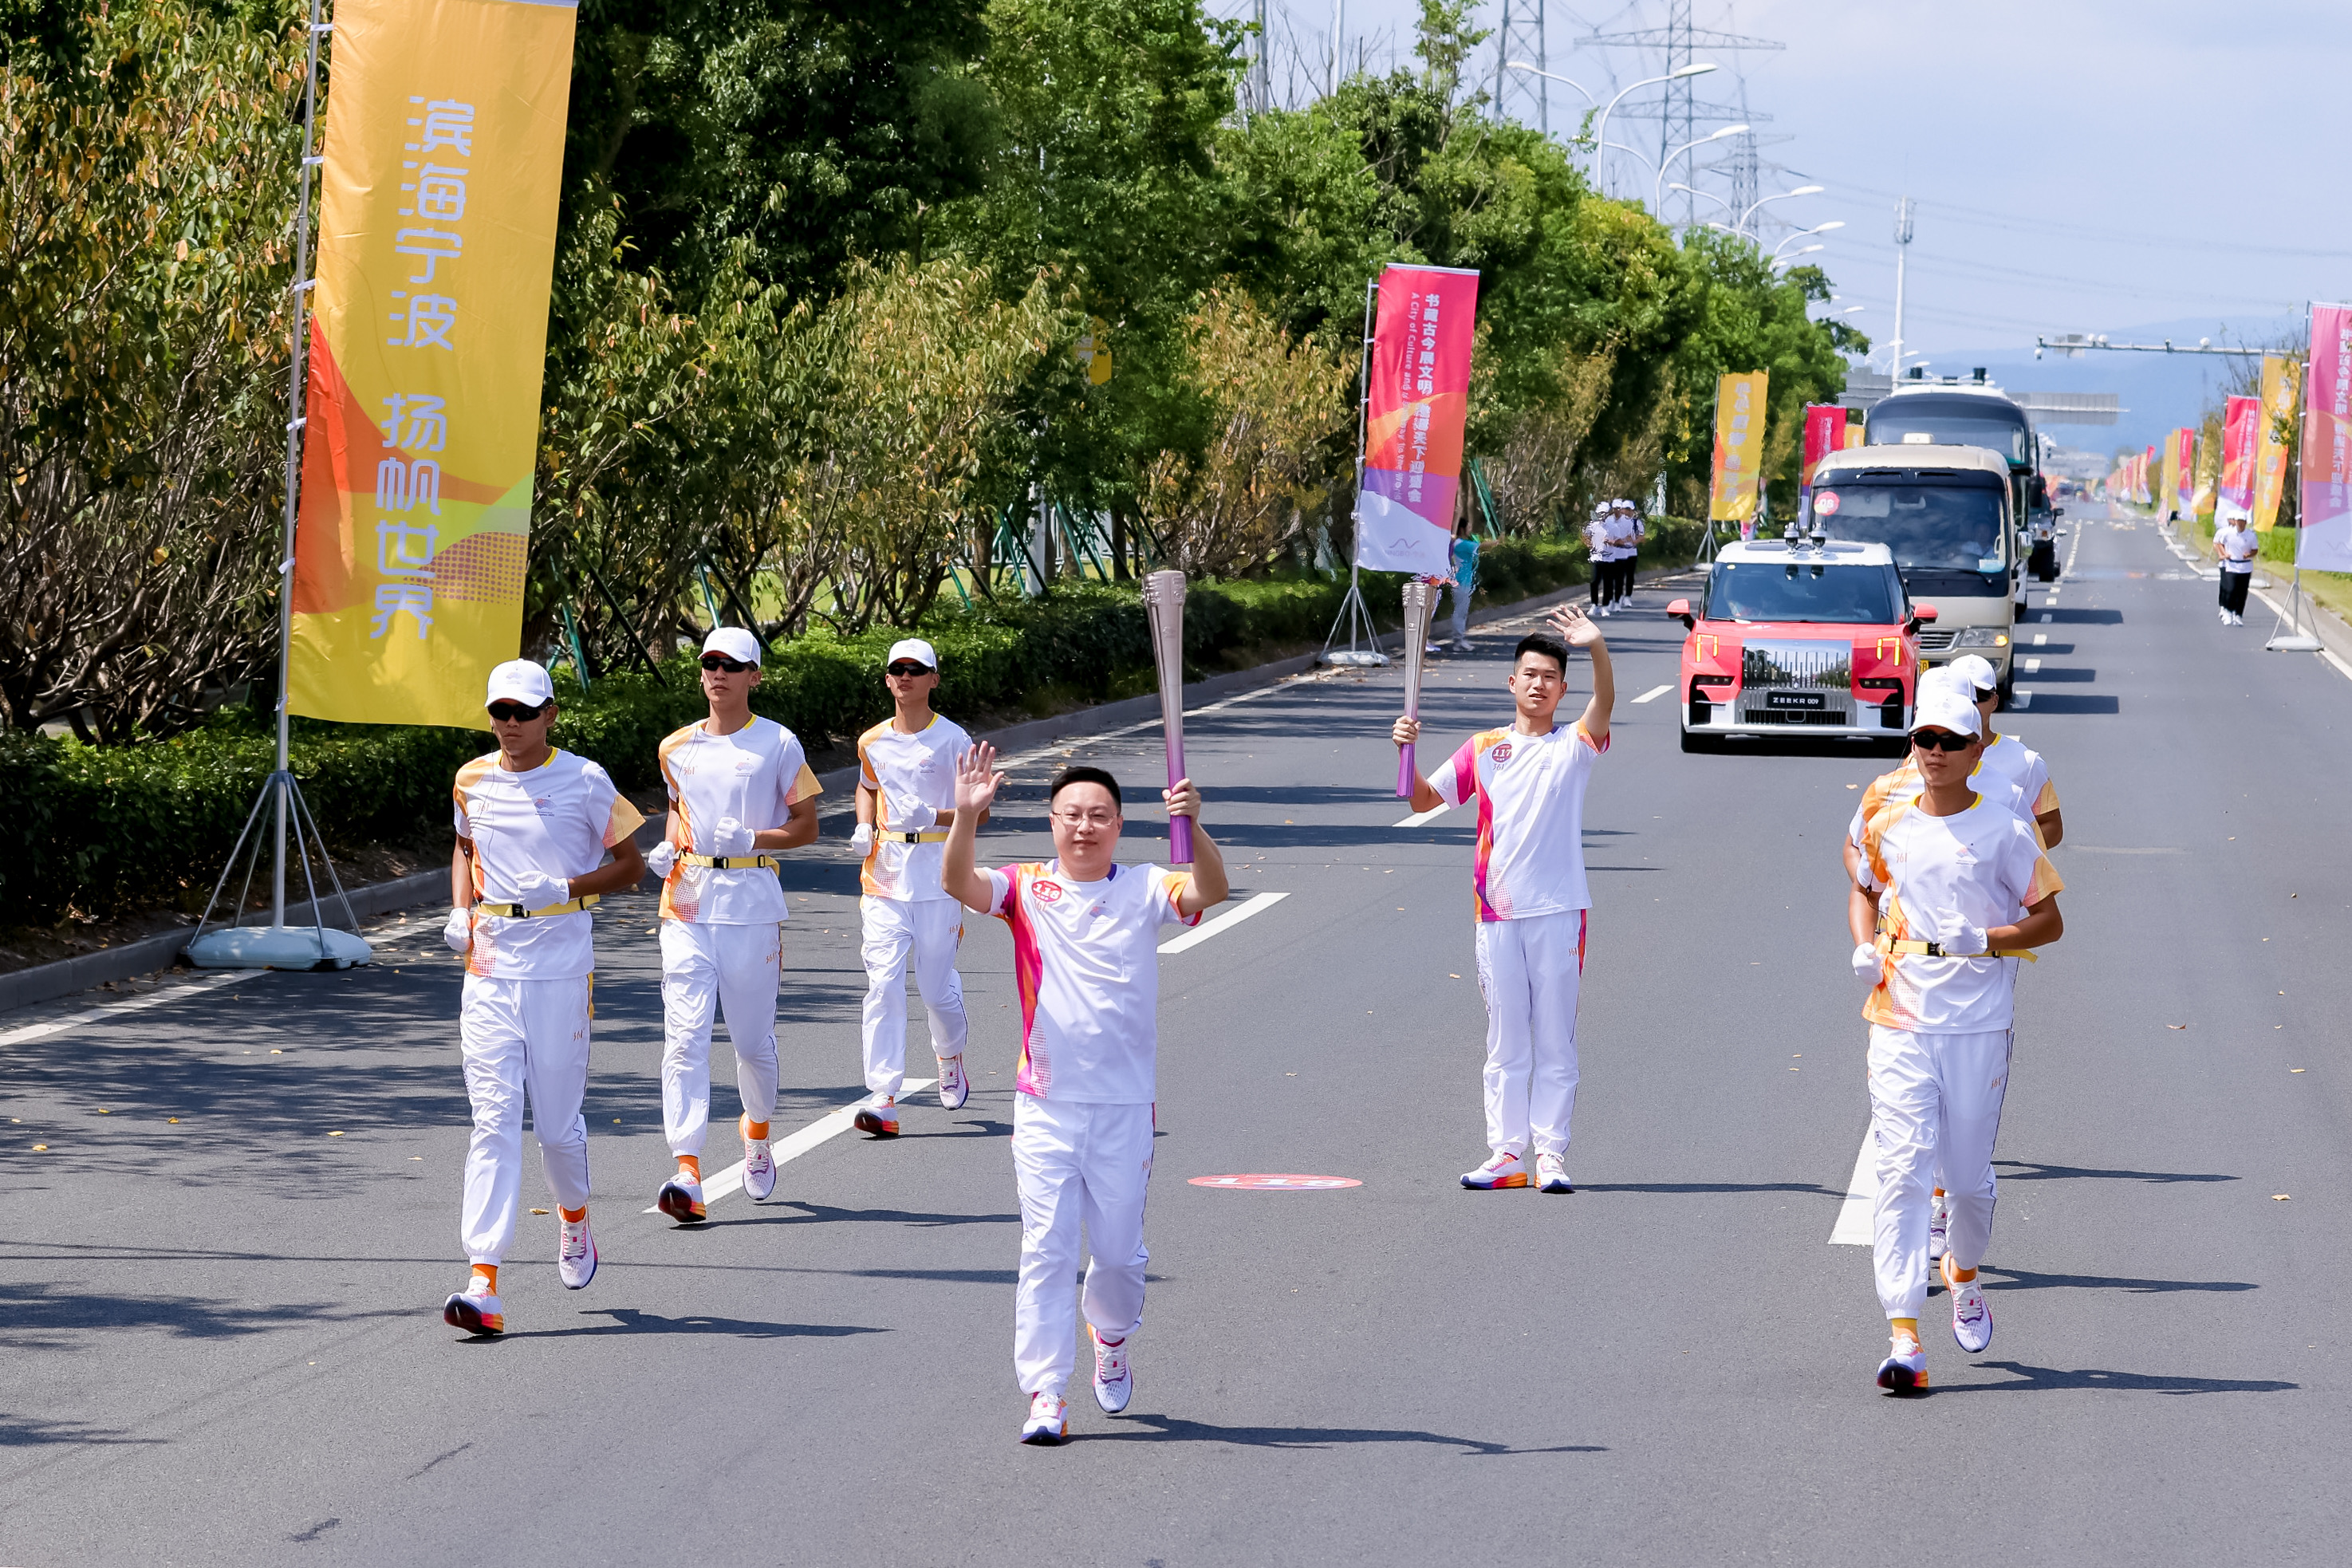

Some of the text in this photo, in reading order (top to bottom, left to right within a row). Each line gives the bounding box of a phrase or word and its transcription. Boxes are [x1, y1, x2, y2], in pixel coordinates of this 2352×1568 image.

[1408, 301, 1419, 320] City
[1409, 322, 1417, 332] of
[1405, 334, 1416, 369] Culture
[370, 95, 475, 641] 滨海宁波 扬帆世界
[1493, 748, 1512, 757] 117
[1033, 883, 1061, 900] 118
[1204, 1177, 1346, 1187] 118
